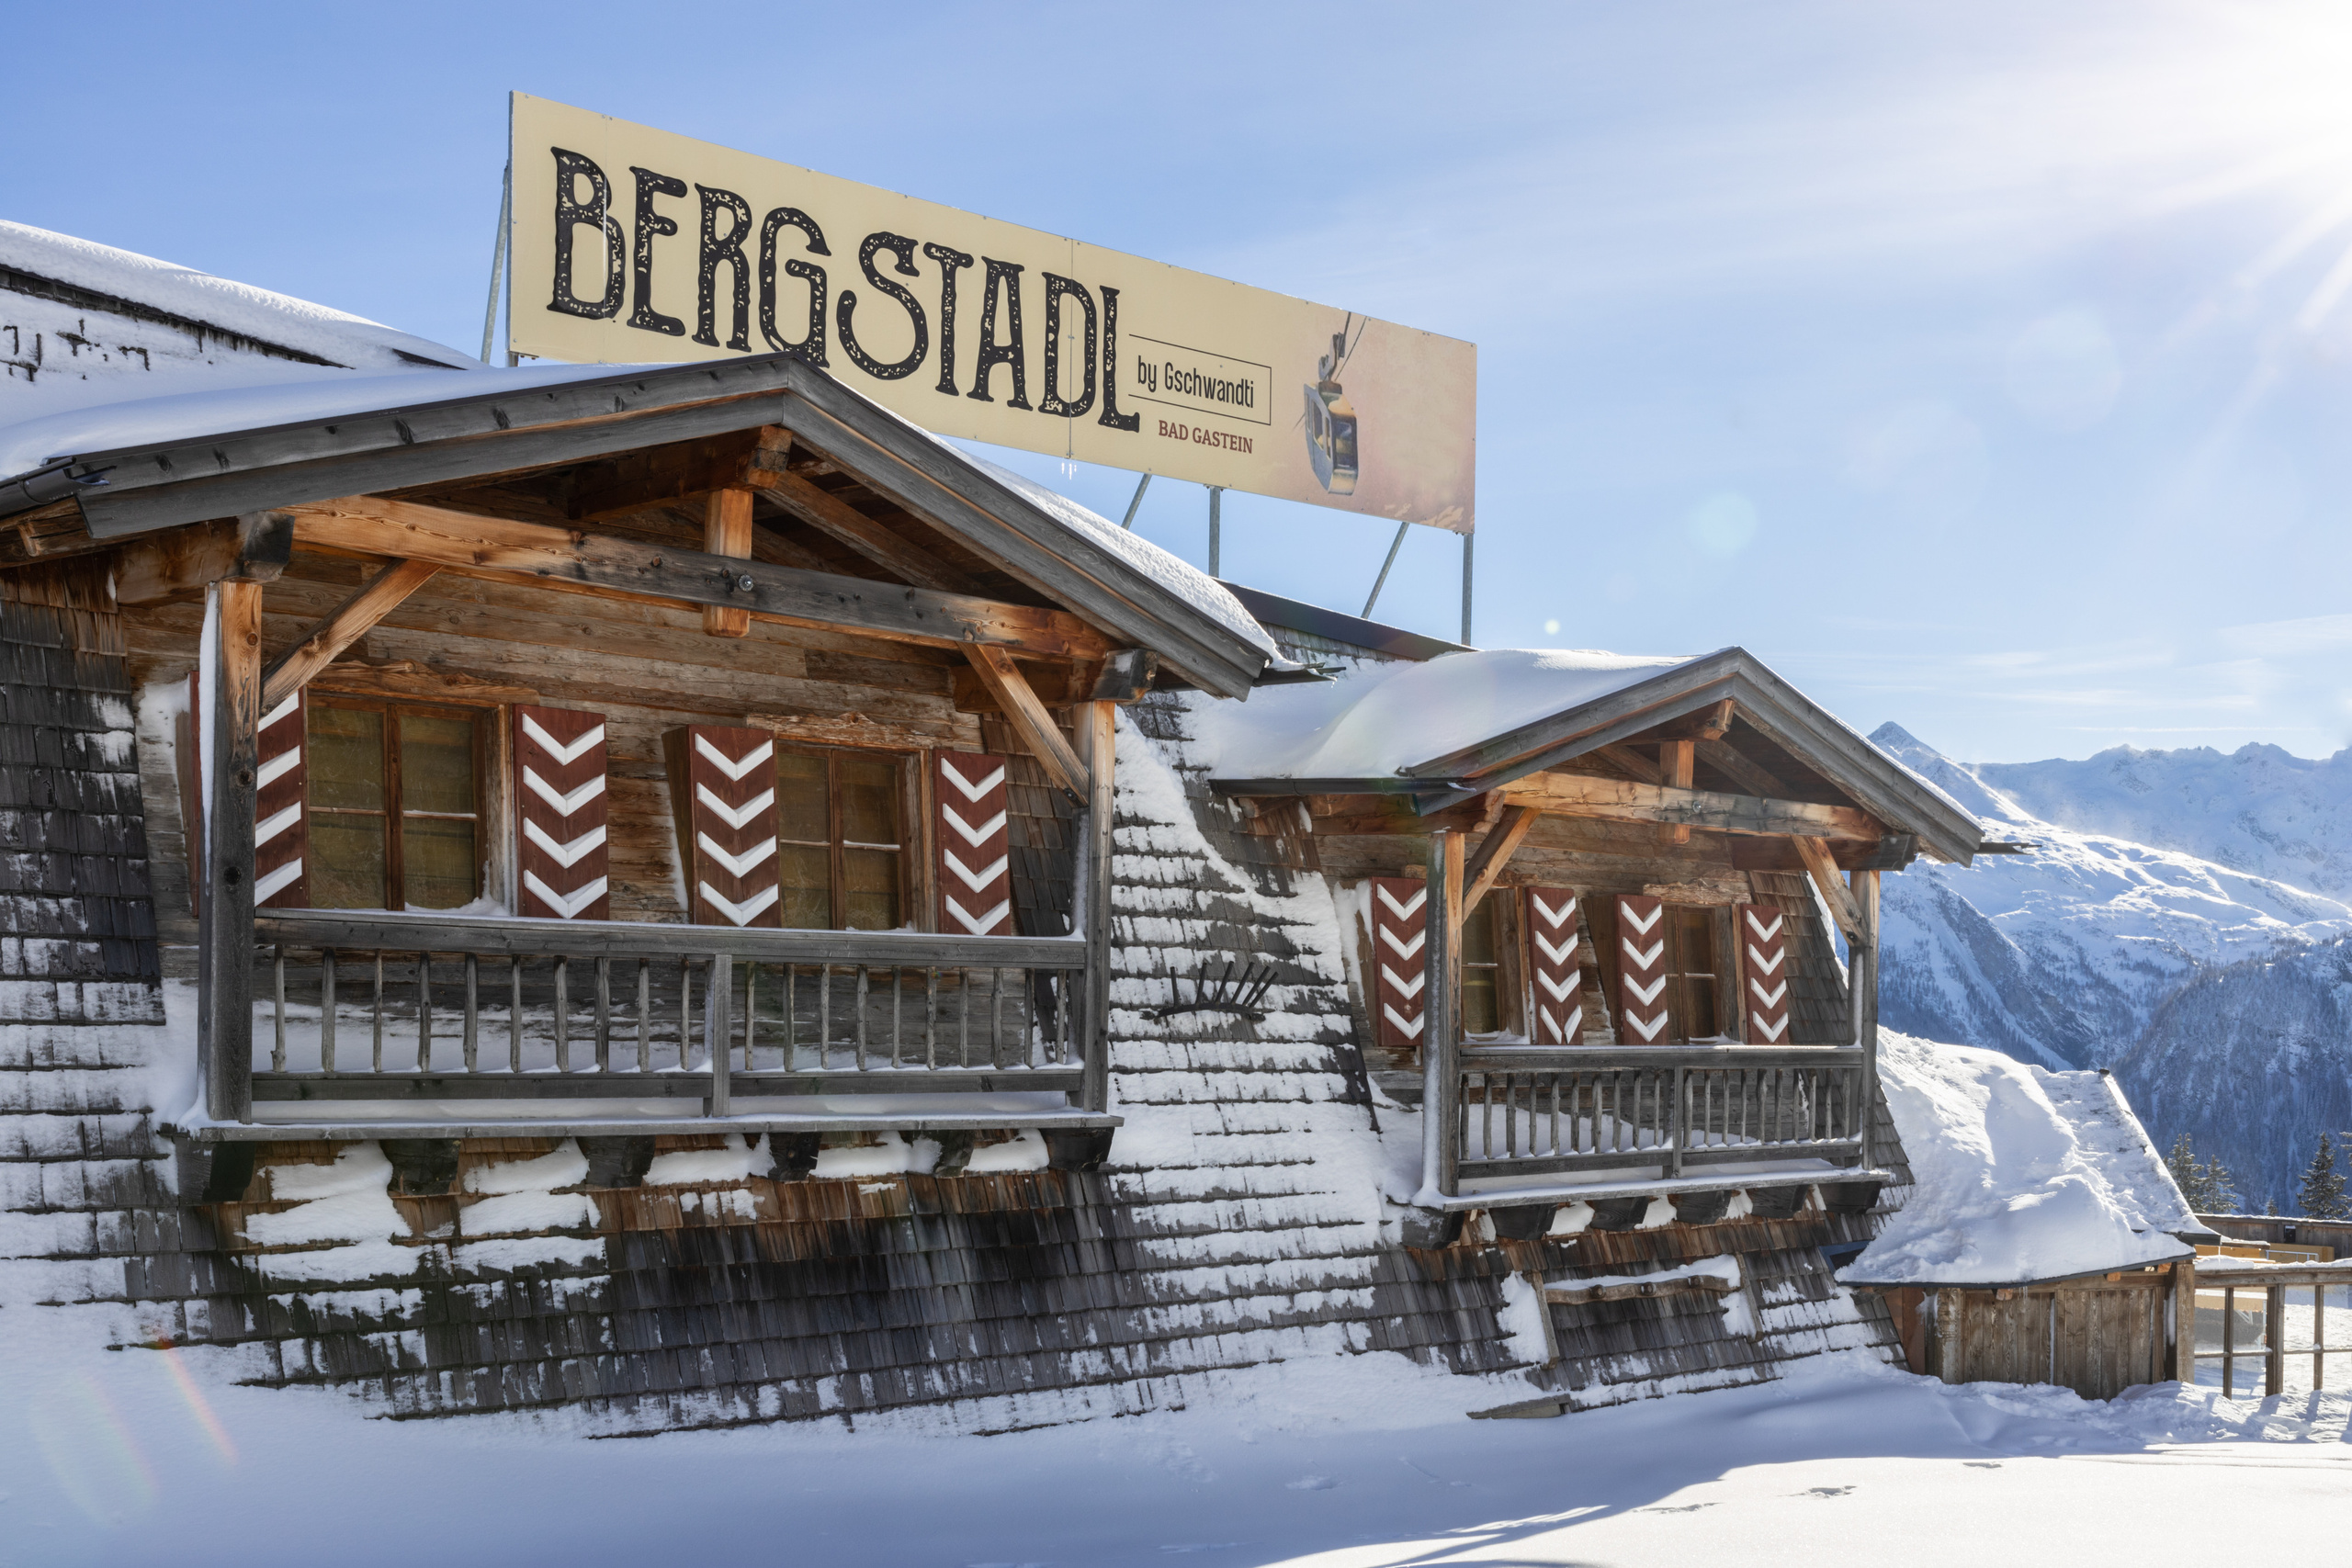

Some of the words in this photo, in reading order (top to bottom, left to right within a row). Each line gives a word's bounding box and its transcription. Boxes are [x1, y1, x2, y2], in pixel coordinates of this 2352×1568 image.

[547, 146, 1139, 433] BERGSTADL
[1137, 355, 1157, 392] by
[1164, 363, 1253, 408] Gschwandti
[1159, 421, 1188, 440] BAD
[1193, 428, 1252, 454] GASTEIN
